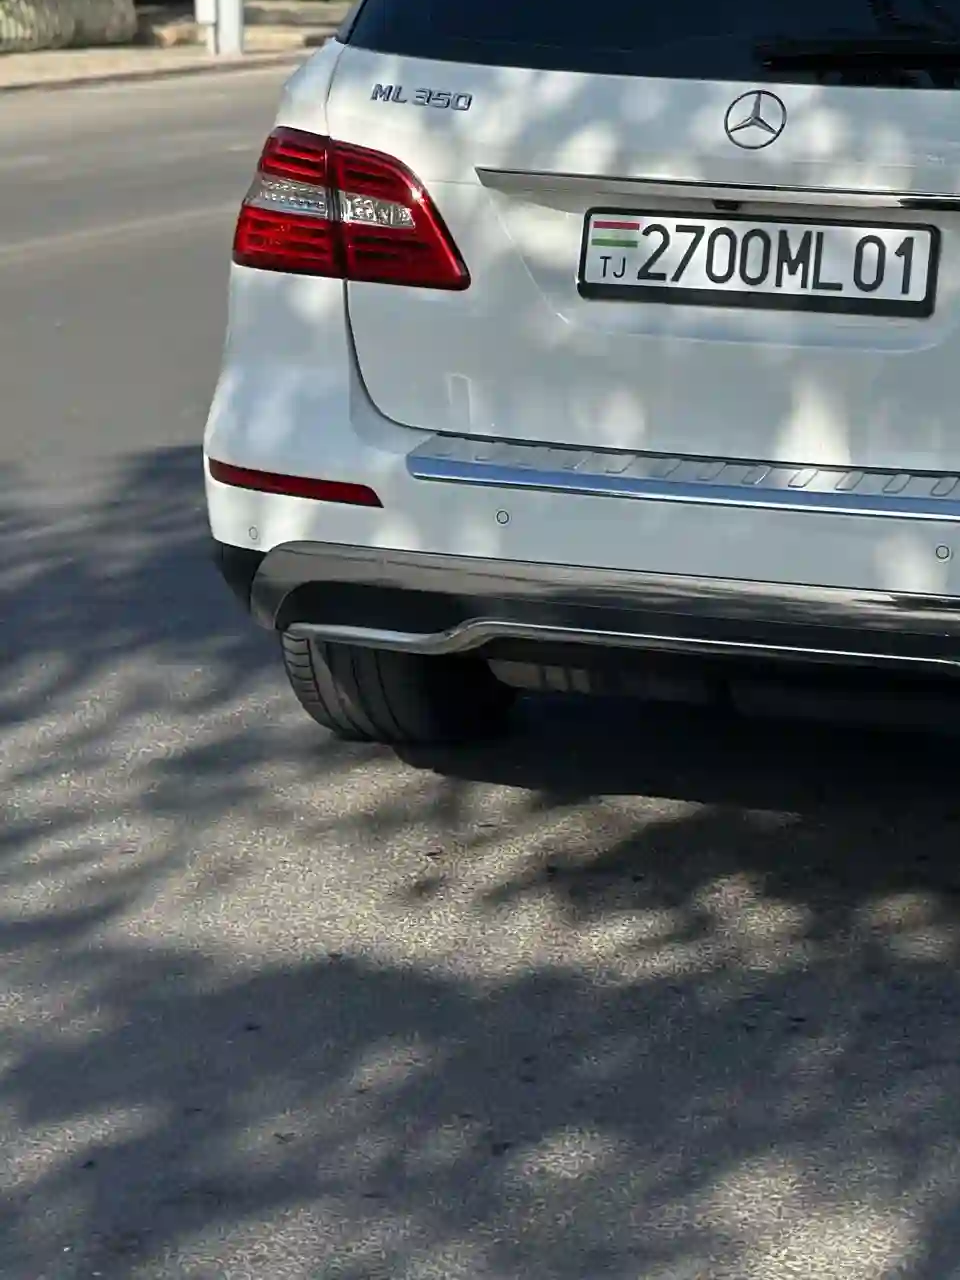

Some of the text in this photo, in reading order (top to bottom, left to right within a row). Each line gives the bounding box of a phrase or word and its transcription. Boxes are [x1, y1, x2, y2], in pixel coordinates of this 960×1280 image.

[370, 83, 474, 111] ML 350
[599, 254, 628, 279] TJ
